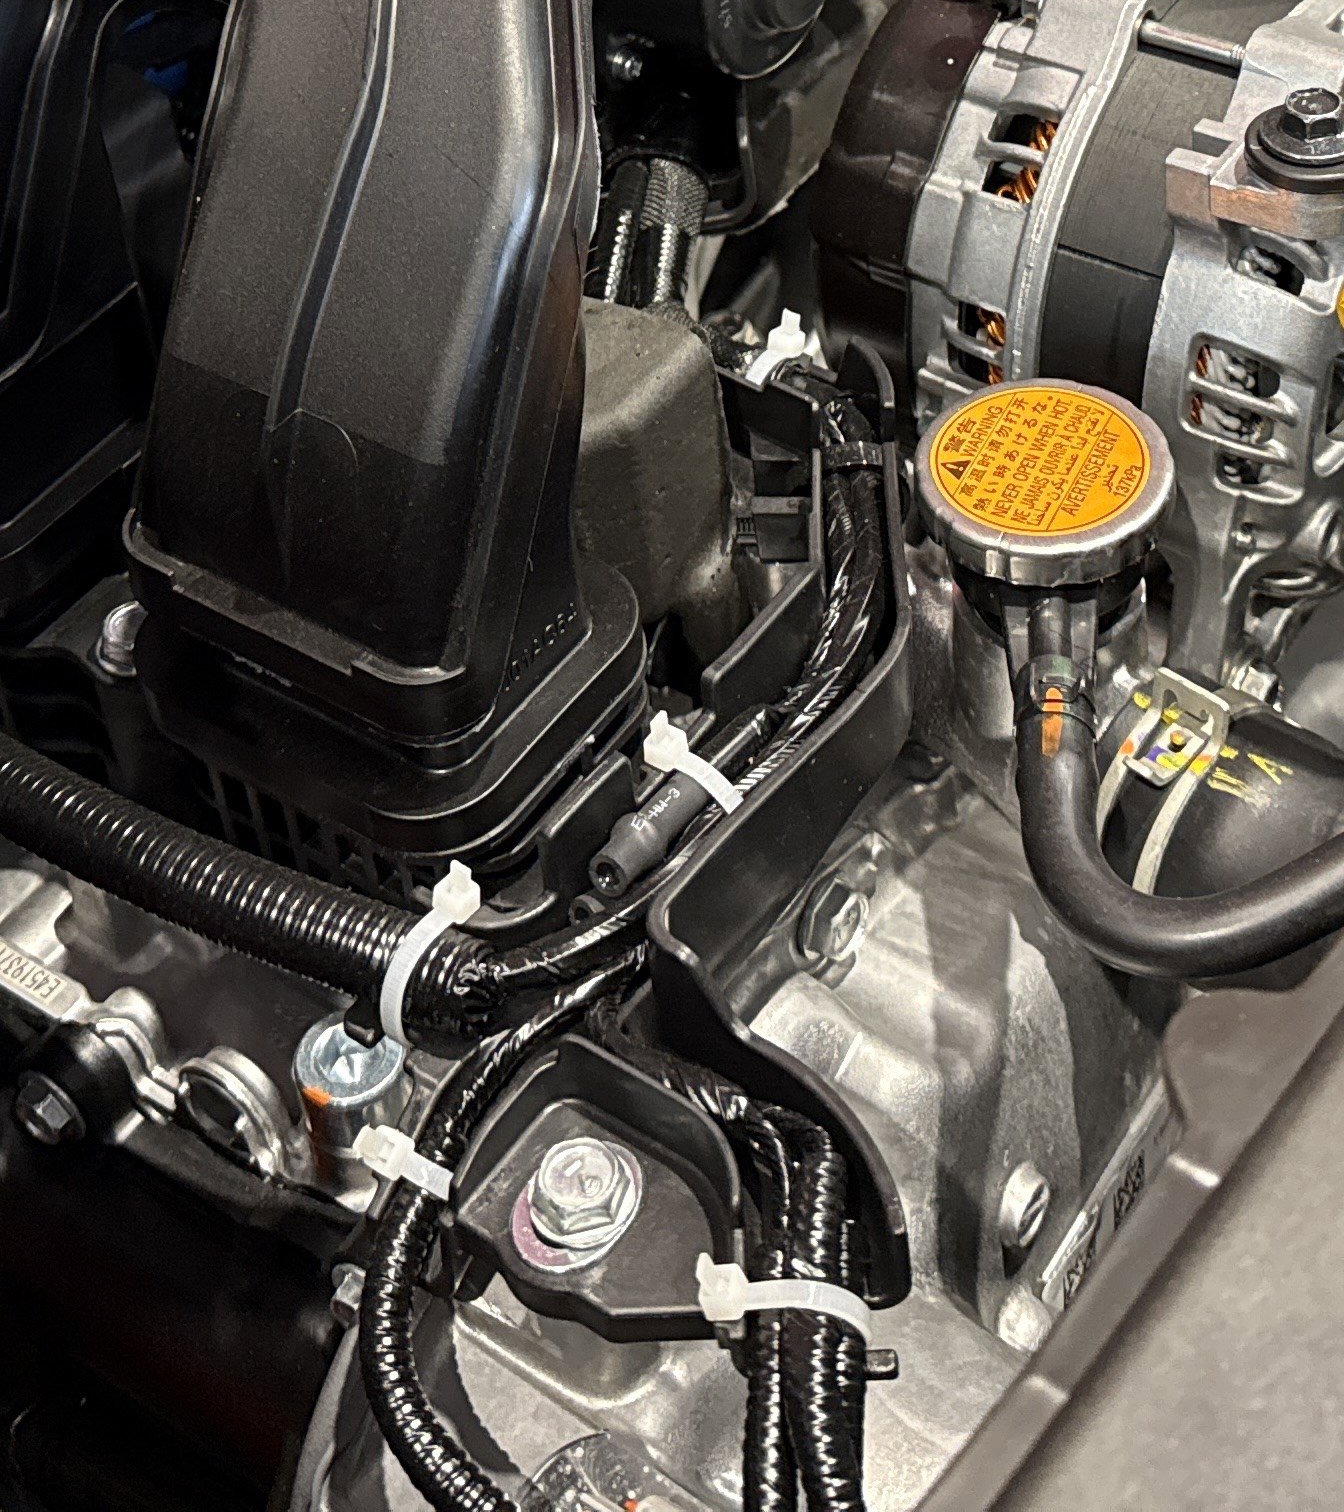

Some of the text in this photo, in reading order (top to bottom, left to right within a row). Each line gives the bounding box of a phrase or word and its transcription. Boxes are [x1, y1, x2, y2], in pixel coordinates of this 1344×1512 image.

[959, 405, 1004, 459] WARNING
[989, 481, 1024, 519] NEVER
[1011, 452, 1041, 482] OPEN
[1029, 420, 1059, 451] WHEN
[1038, 443, 1070, 475] OUVRIR
[1060, 428, 1120, 517] AVERTISSEMENT
[1019, 475, 1050, 511] JAMAIS
[1112, 463, 1143, 500] 137kPa
[1009, 507, 1031, 524] NE
